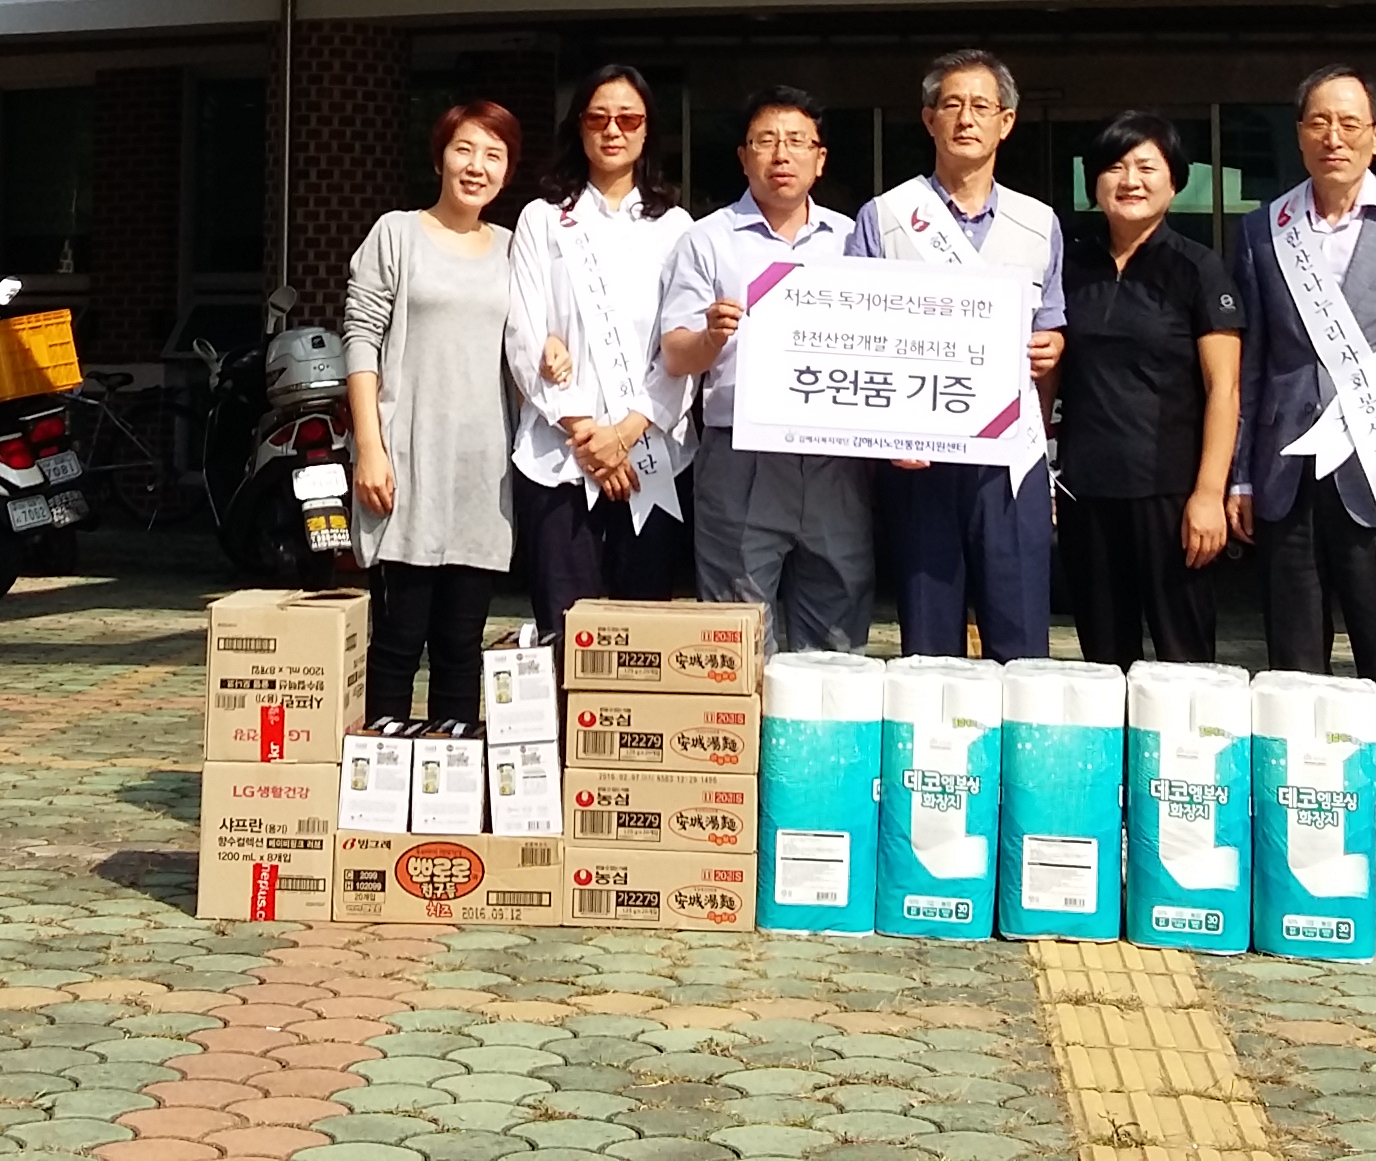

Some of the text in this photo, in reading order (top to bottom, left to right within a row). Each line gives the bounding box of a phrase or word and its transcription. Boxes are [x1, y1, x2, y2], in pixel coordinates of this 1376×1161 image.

[784, 288, 834, 309] 저소득
[960, 299, 994, 320] 위한
[792, 329, 986, 366] 한전산업개발 김해지점 님
[788, 365, 977, 414] 후원품 기증
[597, 632, 630, 646] 농심
[618, 652, 660, 667] 가2279
[303, 666, 325, 676] 1200
[280, 694, 324, 710] 샤프란
[598, 712, 631, 727] 농심
[620, 733, 662, 748] 가2279
[902, 769, 980, 794] 데코엠보싱
[596, 792, 630, 806] 농심
[1149, 779, 1229, 805] 데코엠보싱
[1277, 785, 1358, 812] 데코엠보싱
[921, 793, 962, 812] 화장지
[1168, 802, 1211, 822] 화장지
[1297, 809, 1340, 829] 화장지
[219, 817, 263, 833] 샤프란
[618, 813, 660, 827] 가2279
[358, 838, 392, 851] 빙그레
[217, 852, 240, 861] 1200
[267, 852, 292, 863] 8개입
[595, 870, 628, 885] 농심
[617, 892, 659, 907] 가2279
[426, 901, 453, 918] 치즈
[462, 907, 523, 921] 2016.09.12
